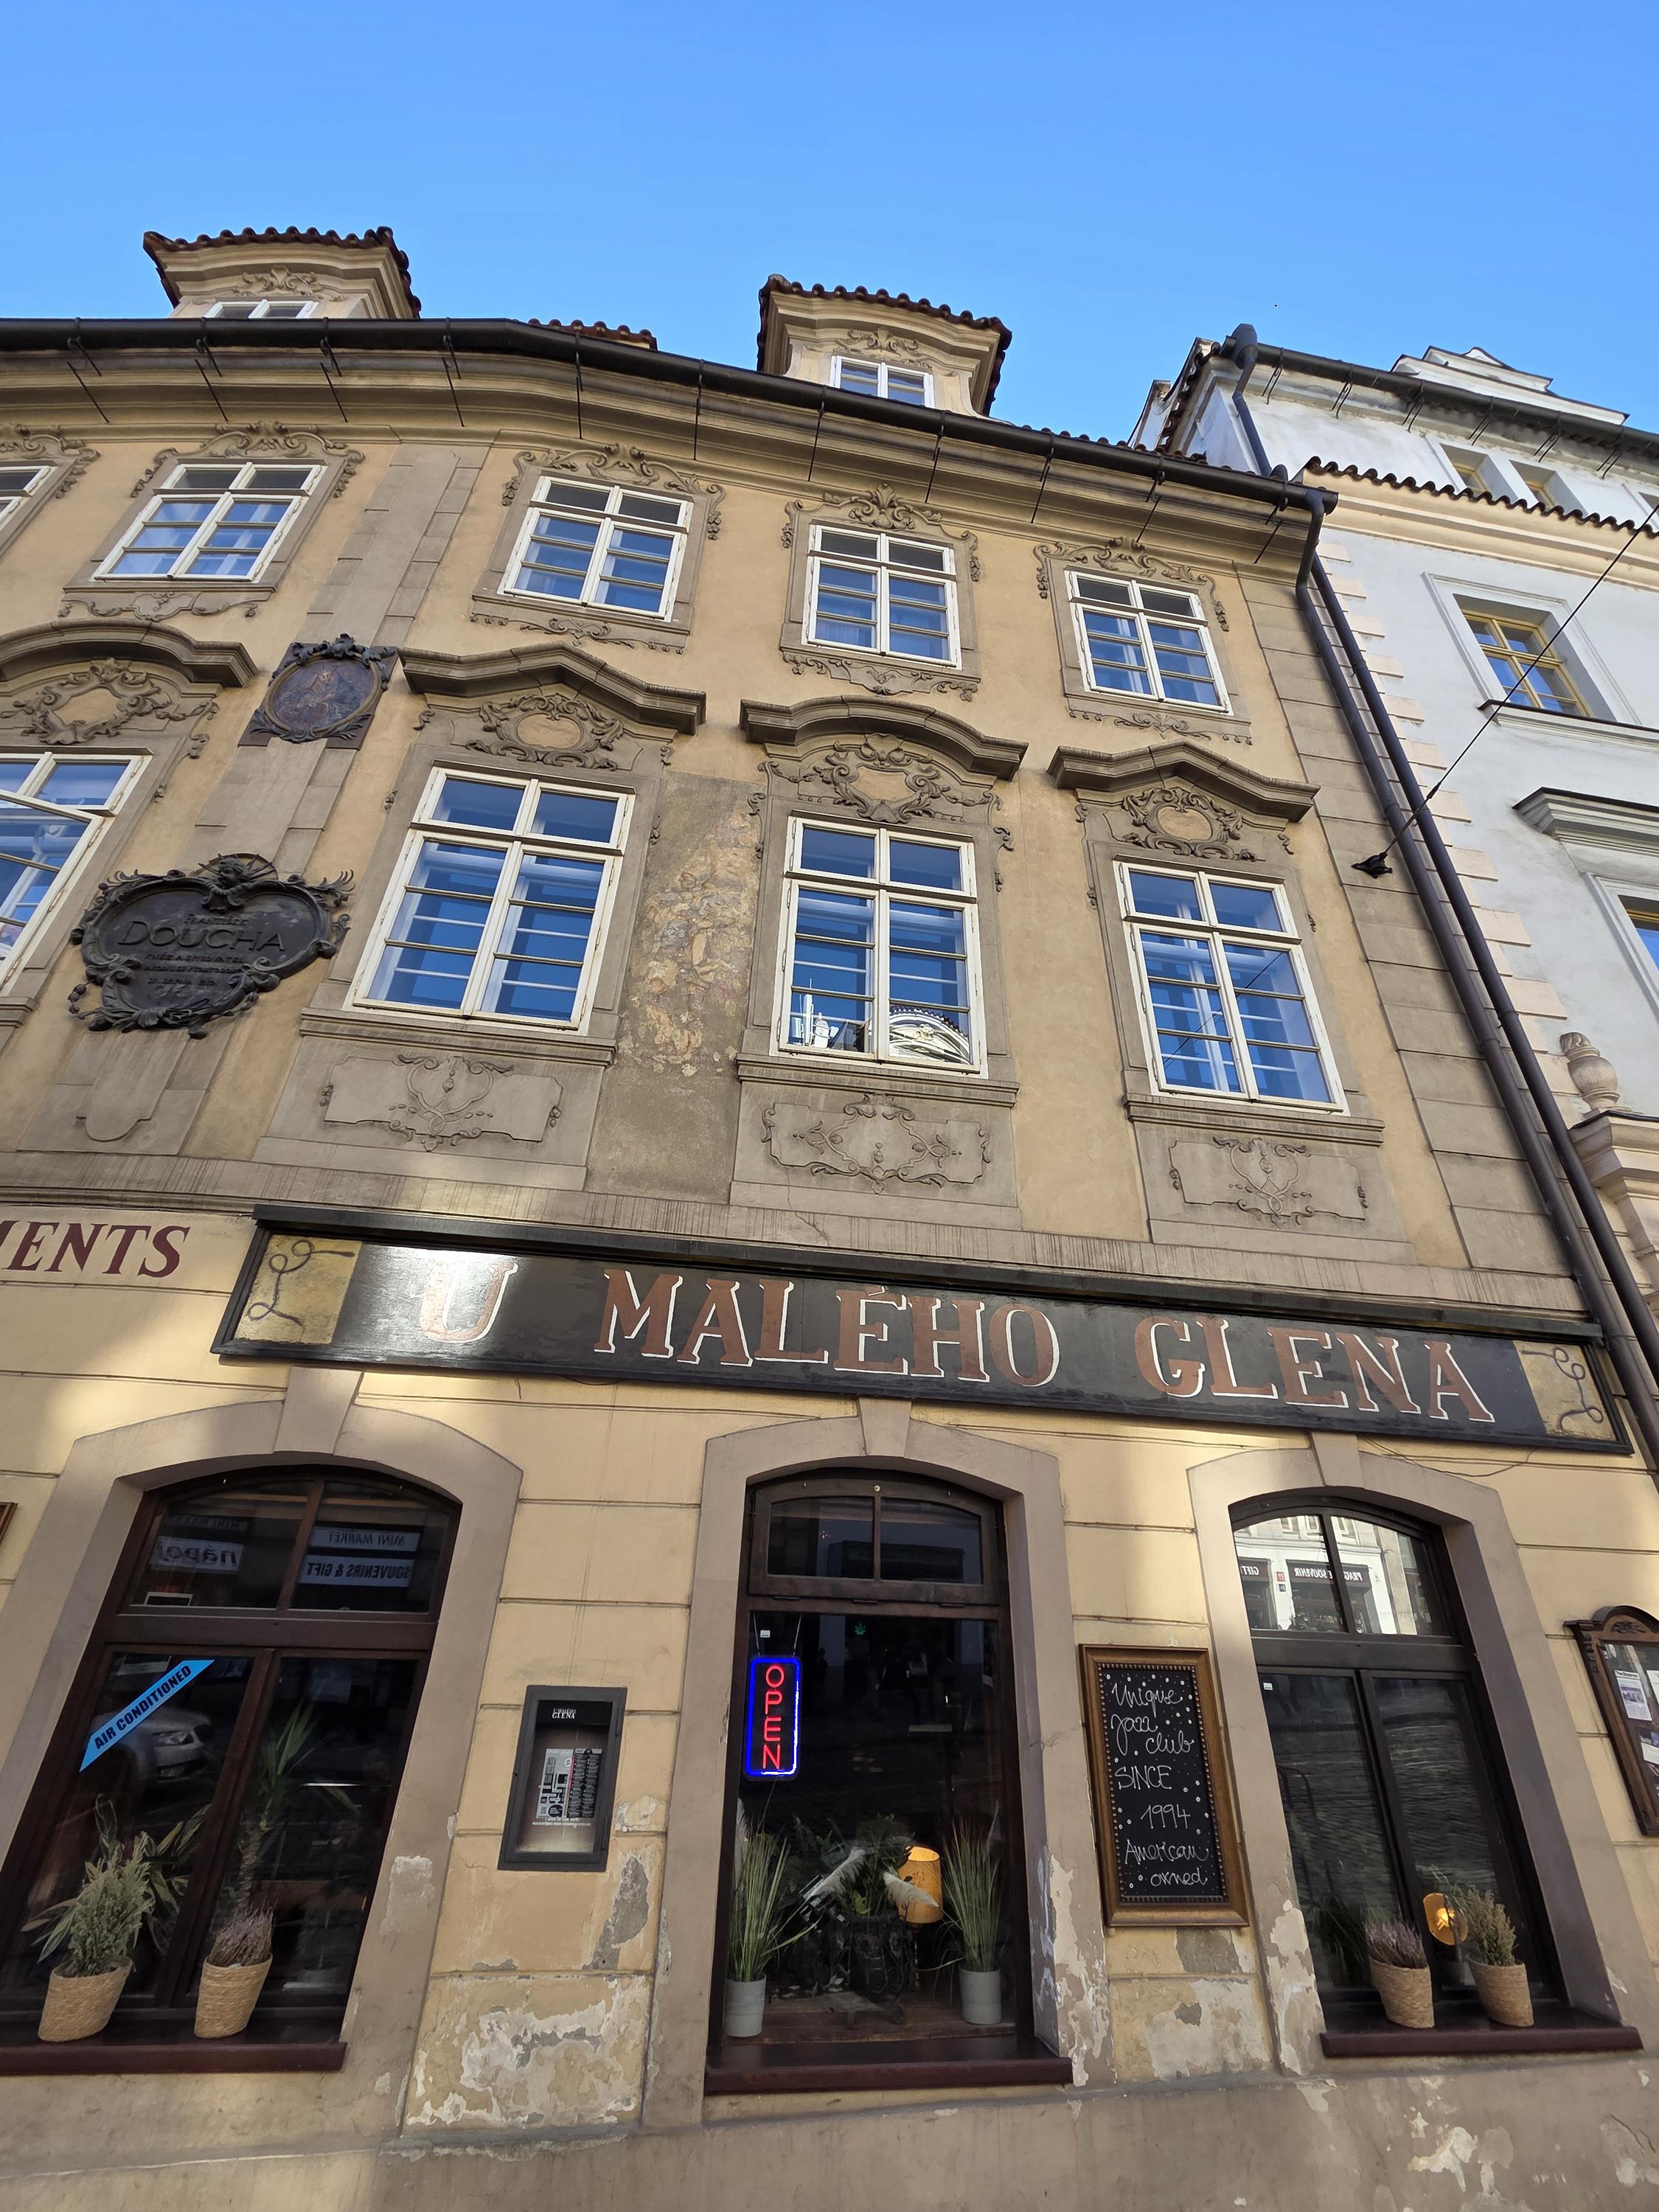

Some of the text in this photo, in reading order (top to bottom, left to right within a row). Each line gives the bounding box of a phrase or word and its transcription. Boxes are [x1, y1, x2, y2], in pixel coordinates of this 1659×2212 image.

[118, 920, 285, 951] DOUCHA
[417, 1256, 1495, 1423] U MALÉHO GLENA
[94, 1665, 192, 1750] AIR CONDITIONED
[1111, 1683, 1183, 1717] Unique
[552, 1711, 575, 1719] GLENA
[762, 1665, 785, 1770] OPEN
[1145, 1731, 1194, 1754] club
[1115, 1765, 1172, 1790] SINCE
[1140, 1804, 1191, 1829] 1994
[1124, 1839, 1209, 1865] American
[1150, 1867, 1208, 1887] owned
